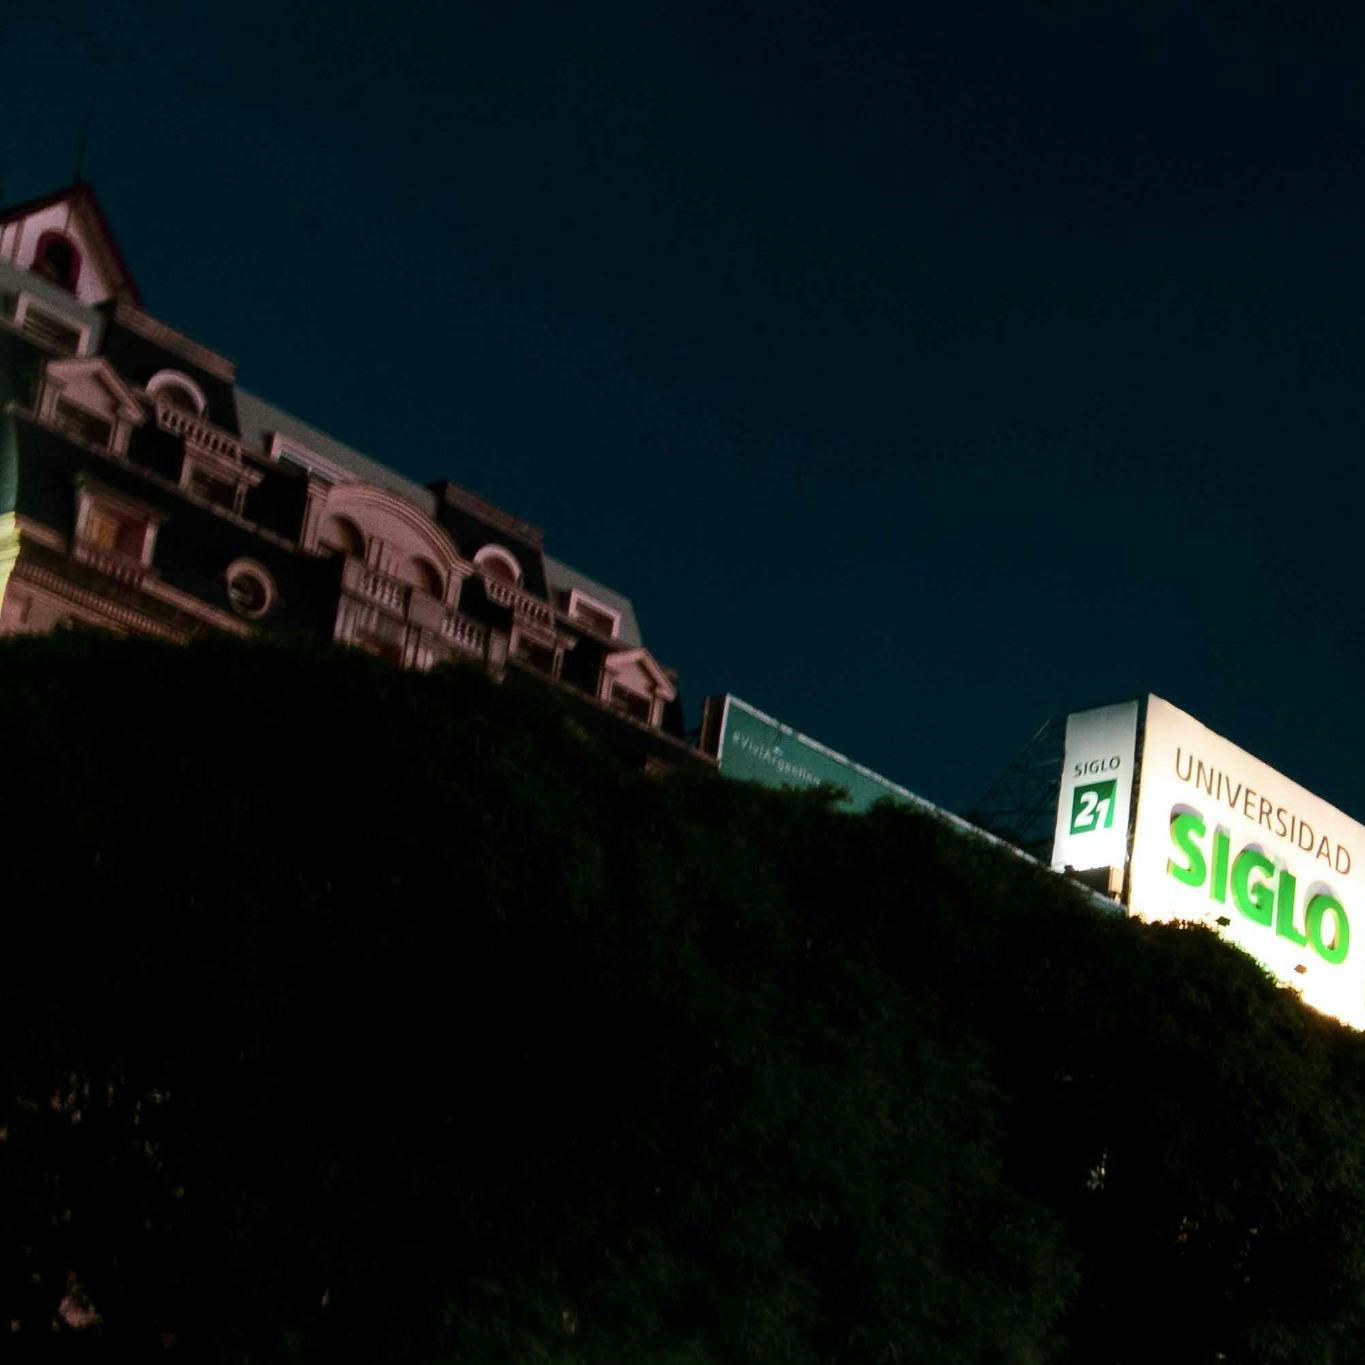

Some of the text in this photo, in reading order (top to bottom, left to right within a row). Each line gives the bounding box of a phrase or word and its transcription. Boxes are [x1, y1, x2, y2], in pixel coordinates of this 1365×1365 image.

[1074, 756, 1121, 778] SIGLO
[1073, 790, 1112, 832] 21
[1176, 747, 1351, 876] UNIVERSIDAD
[1166, 808, 1350, 965] SIGLO
